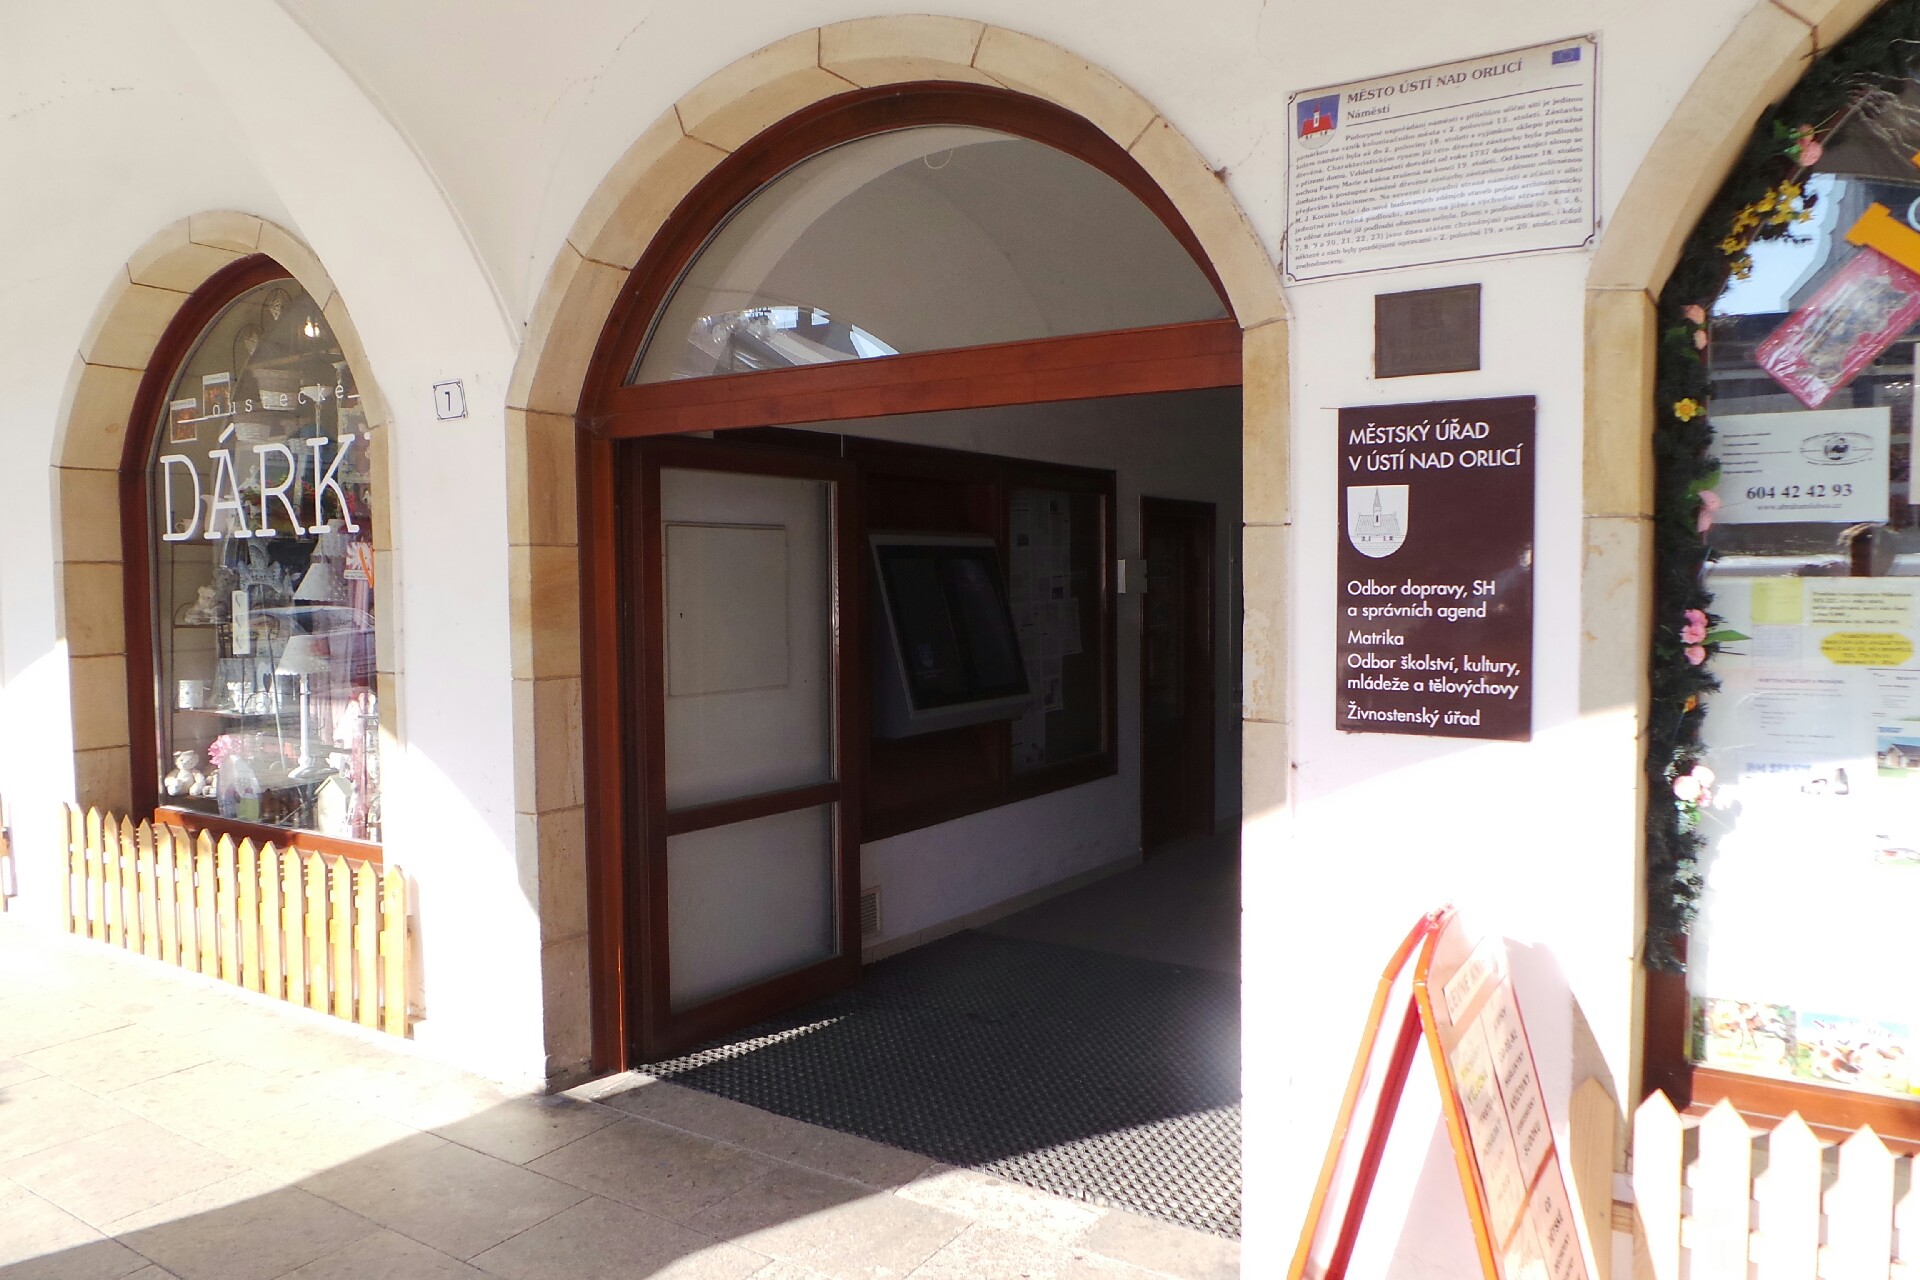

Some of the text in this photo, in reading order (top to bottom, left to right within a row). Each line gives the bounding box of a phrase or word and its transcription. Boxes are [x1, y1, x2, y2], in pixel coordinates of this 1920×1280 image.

[1347, 57, 1523, 104] MĚSTO ÚSTÍ NAD ORLICÍ
[1347, 104, 1391, 120] Náměstí
[1349, 418, 1489, 445] MĚSTSKÝ ÚŘAD
[1349, 443, 1523, 471] V ÚSTÍ NAD ORLICÍ
[160, 423, 371, 541] DÁRK
[1746, 483, 1853, 500] 604 42 42 93
[1348, 579, 1495, 599] Odbor dopravy, SH
[1348, 601, 1486, 621] a správních agend
[1348, 630, 1404, 646] Matrika
[1348, 653, 1521, 676] Odbor školství, kultury,
[1348, 677, 1519, 699] mládeže a tělovýchovy
[1347, 703, 1480, 727] Živnostenský úřad
